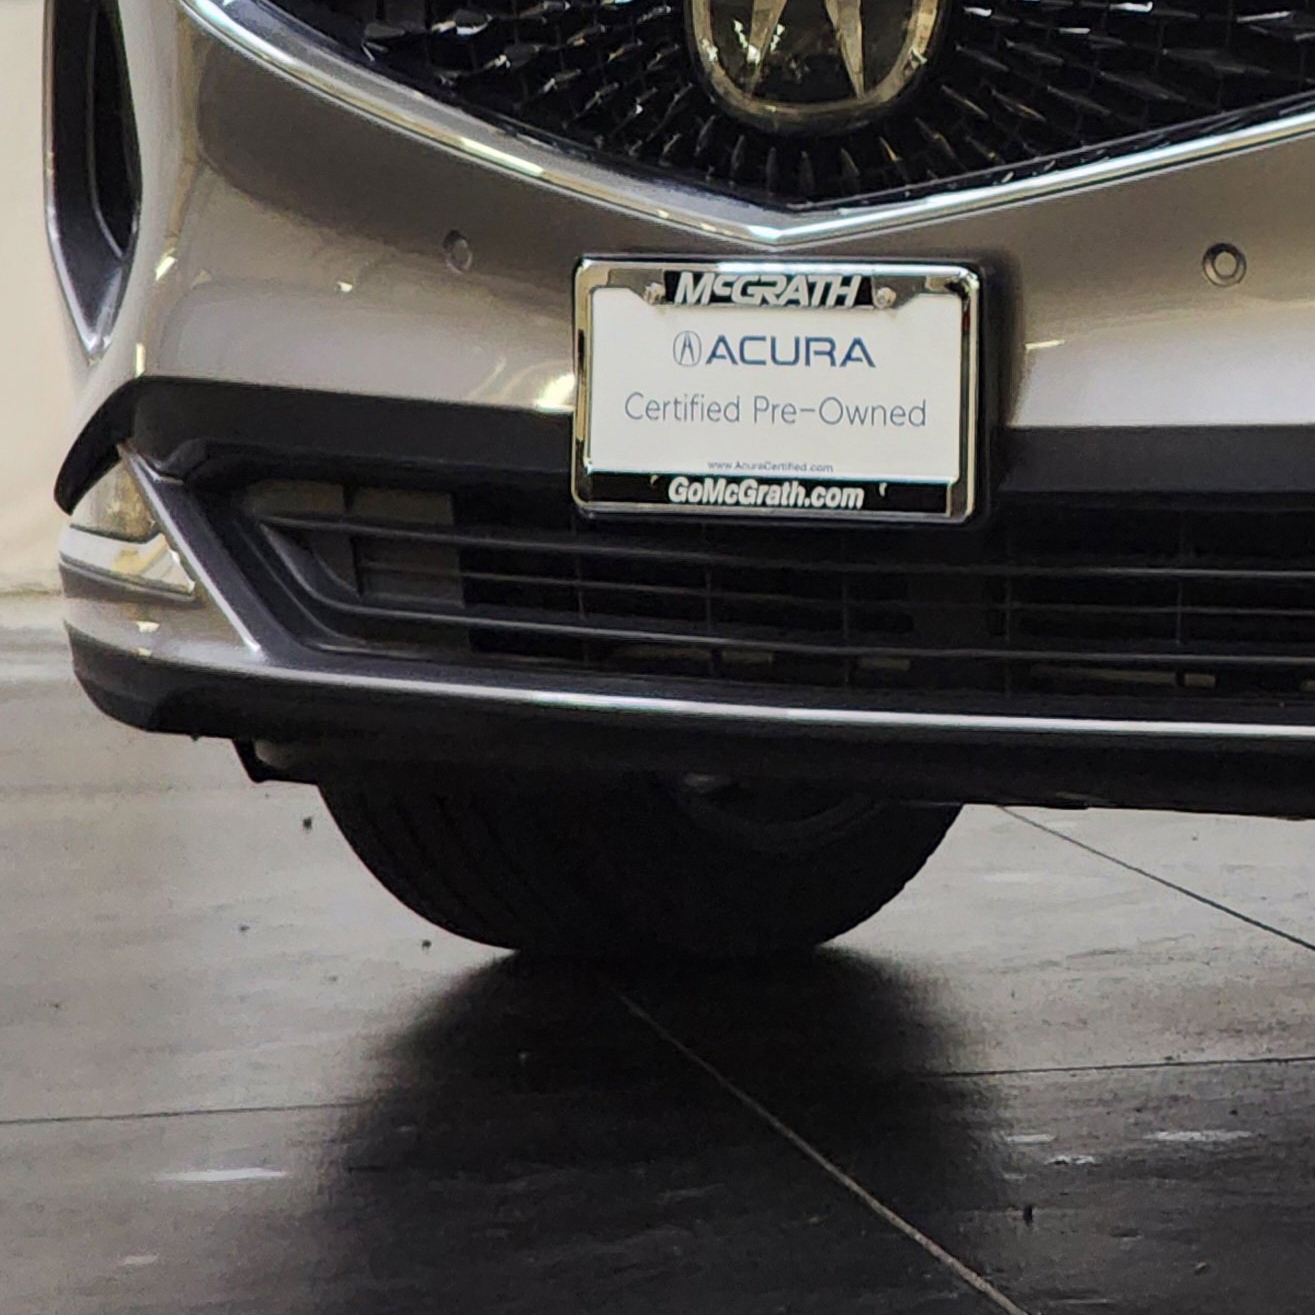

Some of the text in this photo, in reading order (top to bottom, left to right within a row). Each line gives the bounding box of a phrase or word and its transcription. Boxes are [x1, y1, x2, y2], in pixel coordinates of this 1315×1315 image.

[705, 335, 877, 369] ACURA
[624, 391, 927, 428] Certified Pre-Owned
[668, 476, 865, 511] GoMcGrath.com
